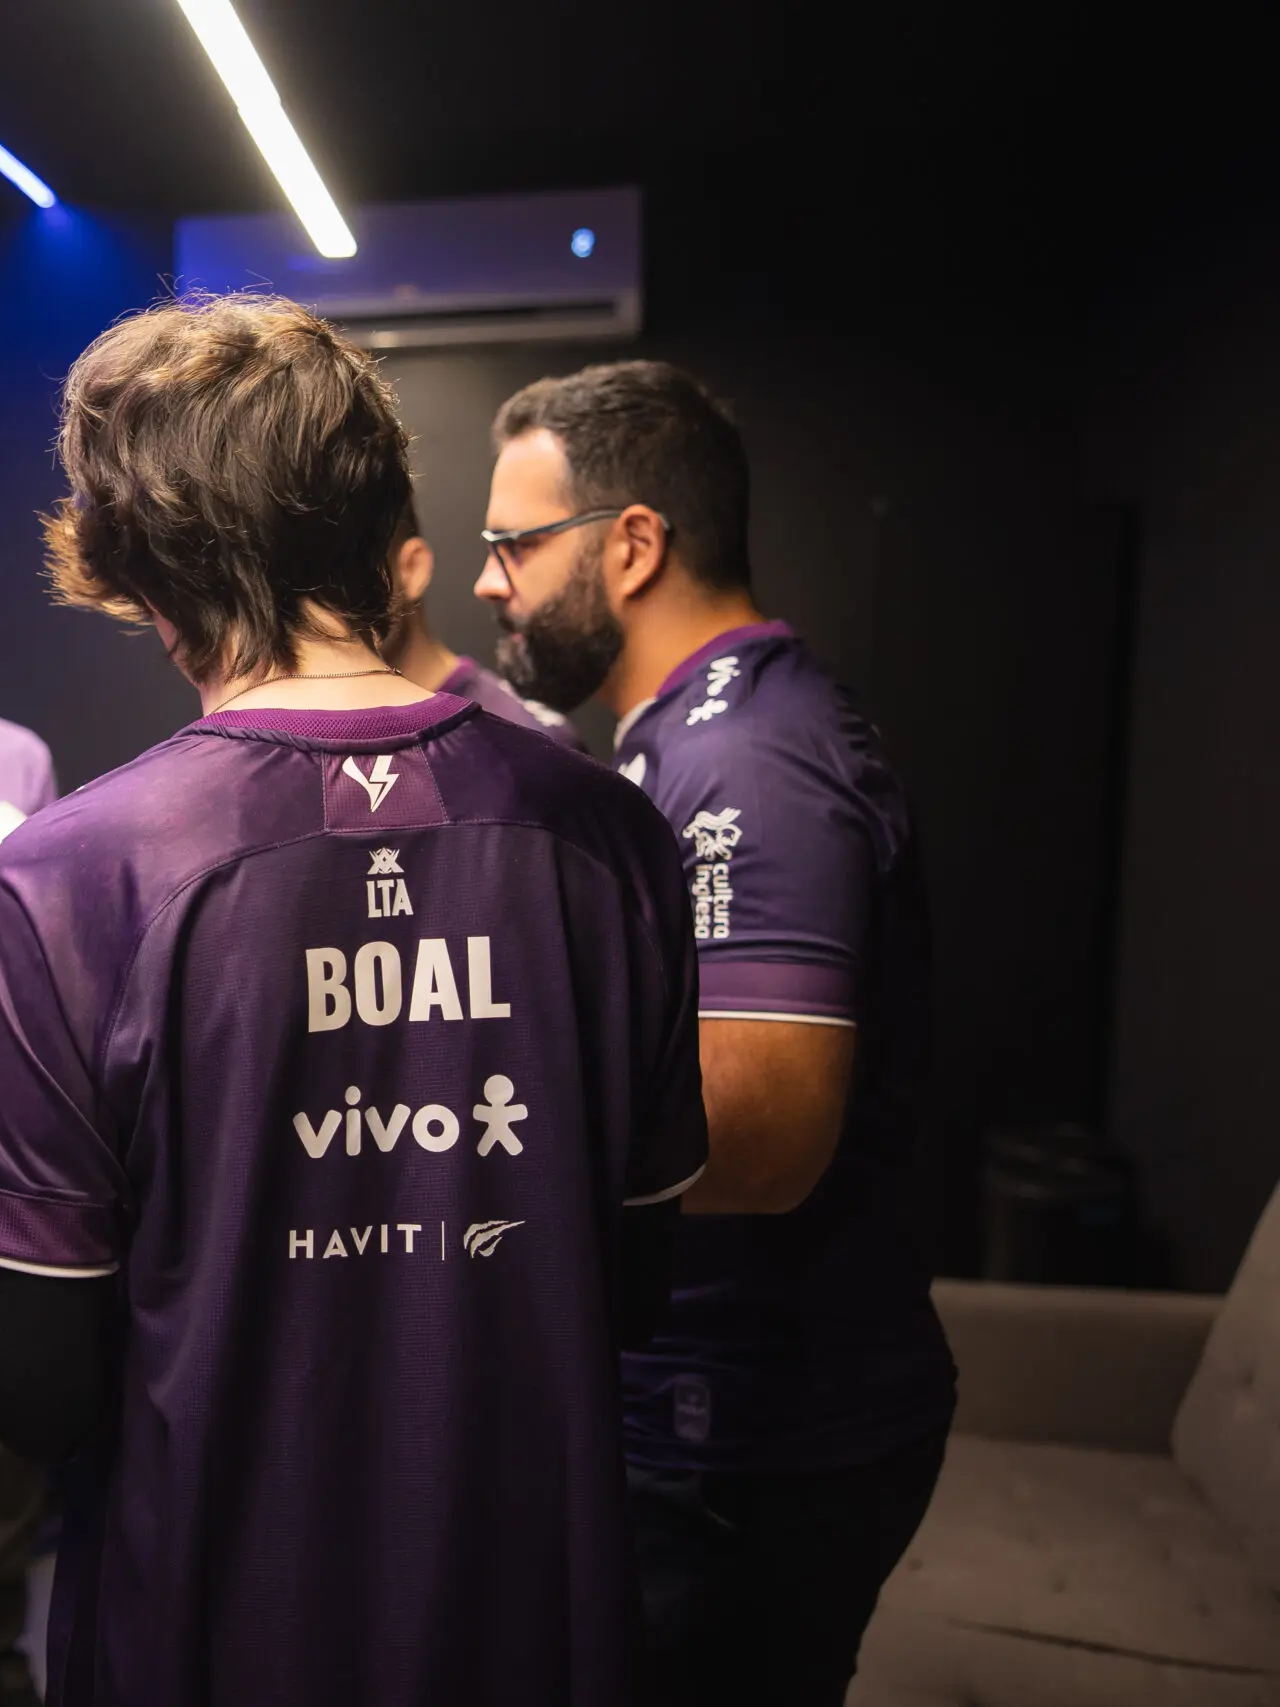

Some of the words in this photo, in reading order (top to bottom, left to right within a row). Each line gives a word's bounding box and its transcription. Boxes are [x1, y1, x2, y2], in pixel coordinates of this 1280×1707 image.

[366, 877, 414, 919] LTA
[691, 863, 714, 940] inglesa
[712, 862, 734, 939] cultura
[305, 935, 512, 1034] BOAL
[292, 1084, 461, 1160] vivo
[288, 1223, 423, 1260] HAVIT
